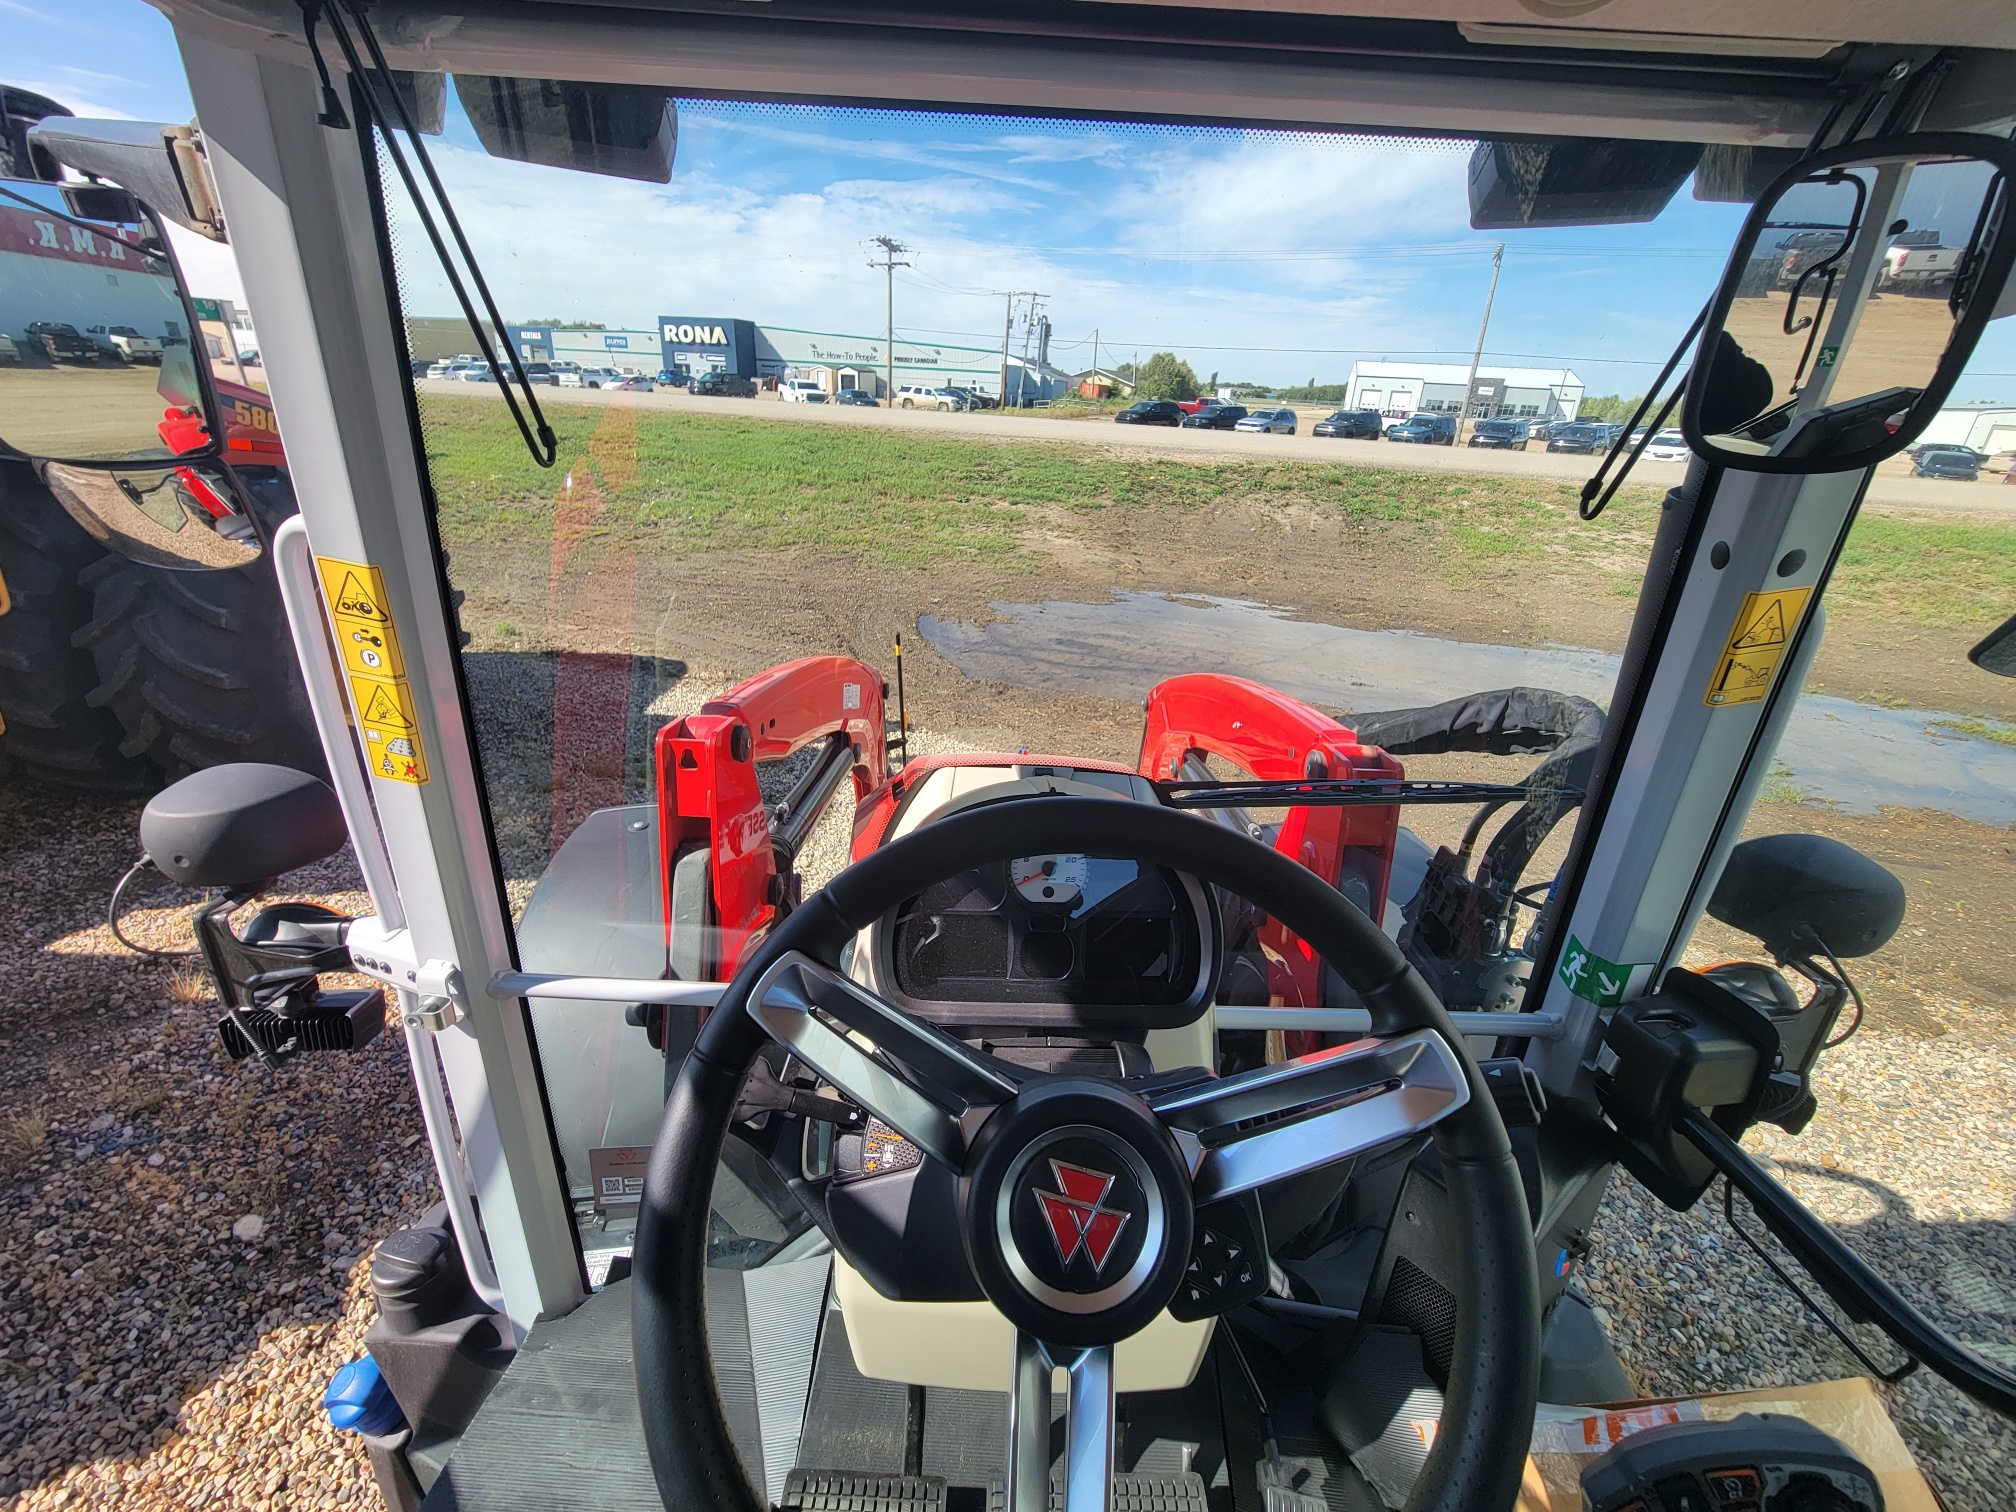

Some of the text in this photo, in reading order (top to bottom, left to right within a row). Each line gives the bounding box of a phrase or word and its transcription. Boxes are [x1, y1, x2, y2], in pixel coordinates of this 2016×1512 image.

[663, 324, 728, 345] RONA
[812, 350, 824, 359] The
[366, 652, 376, 664] P
[1240, 1271, 1252, 1283] OK
